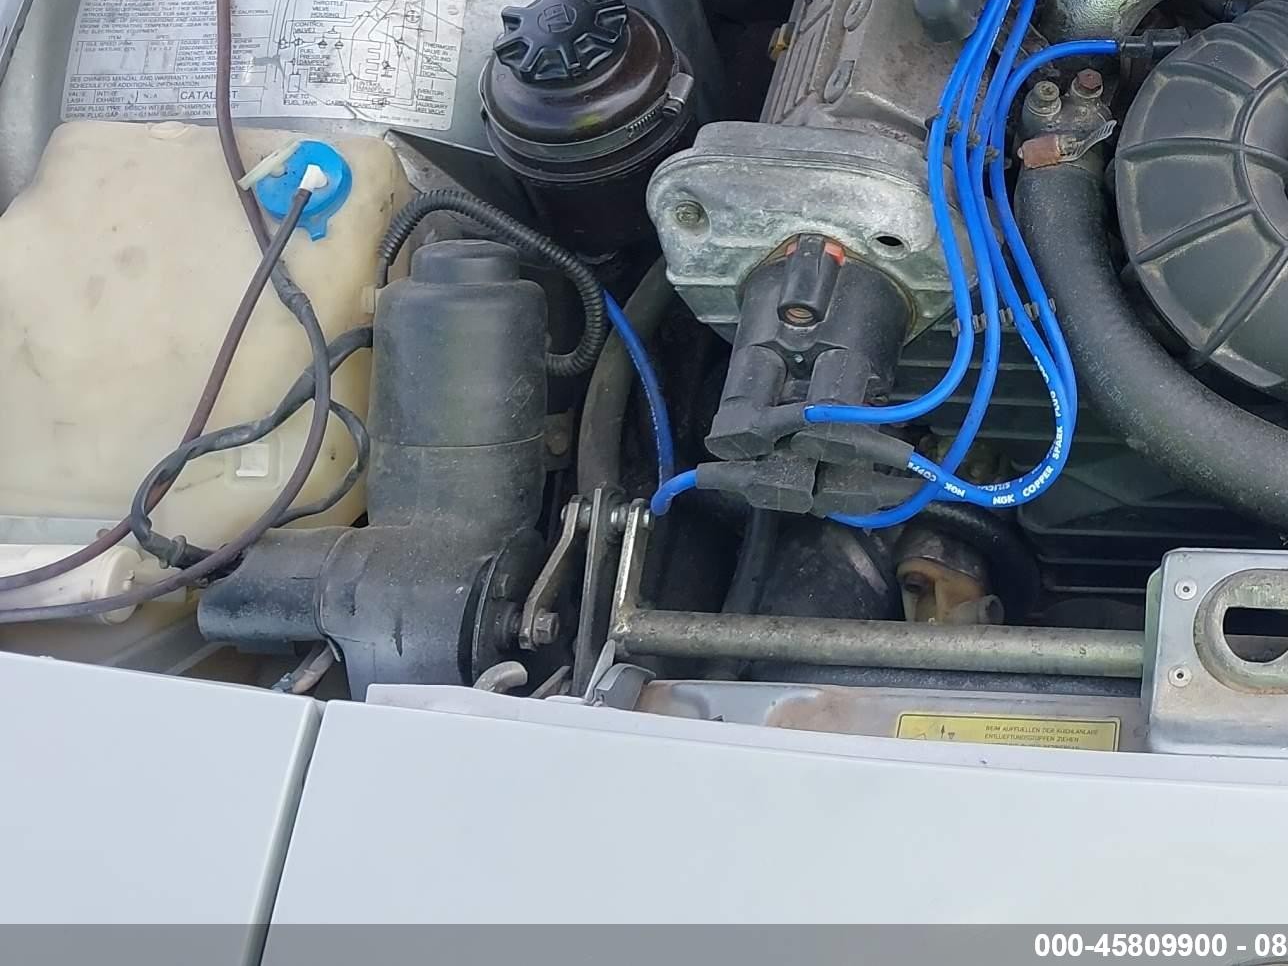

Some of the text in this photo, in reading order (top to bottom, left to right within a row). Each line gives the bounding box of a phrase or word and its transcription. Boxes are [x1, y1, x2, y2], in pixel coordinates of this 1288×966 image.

[180, 90, 238, 100] CATALT
[1050, 390, 1062, 417] PLUG
[1052, 426, 1063, 460] SPARK
[907, 461, 965, 498] COPPE NGK
[1022, 465, 1054, 497] COPPER
[993, 493, 1015, 505] NGK
